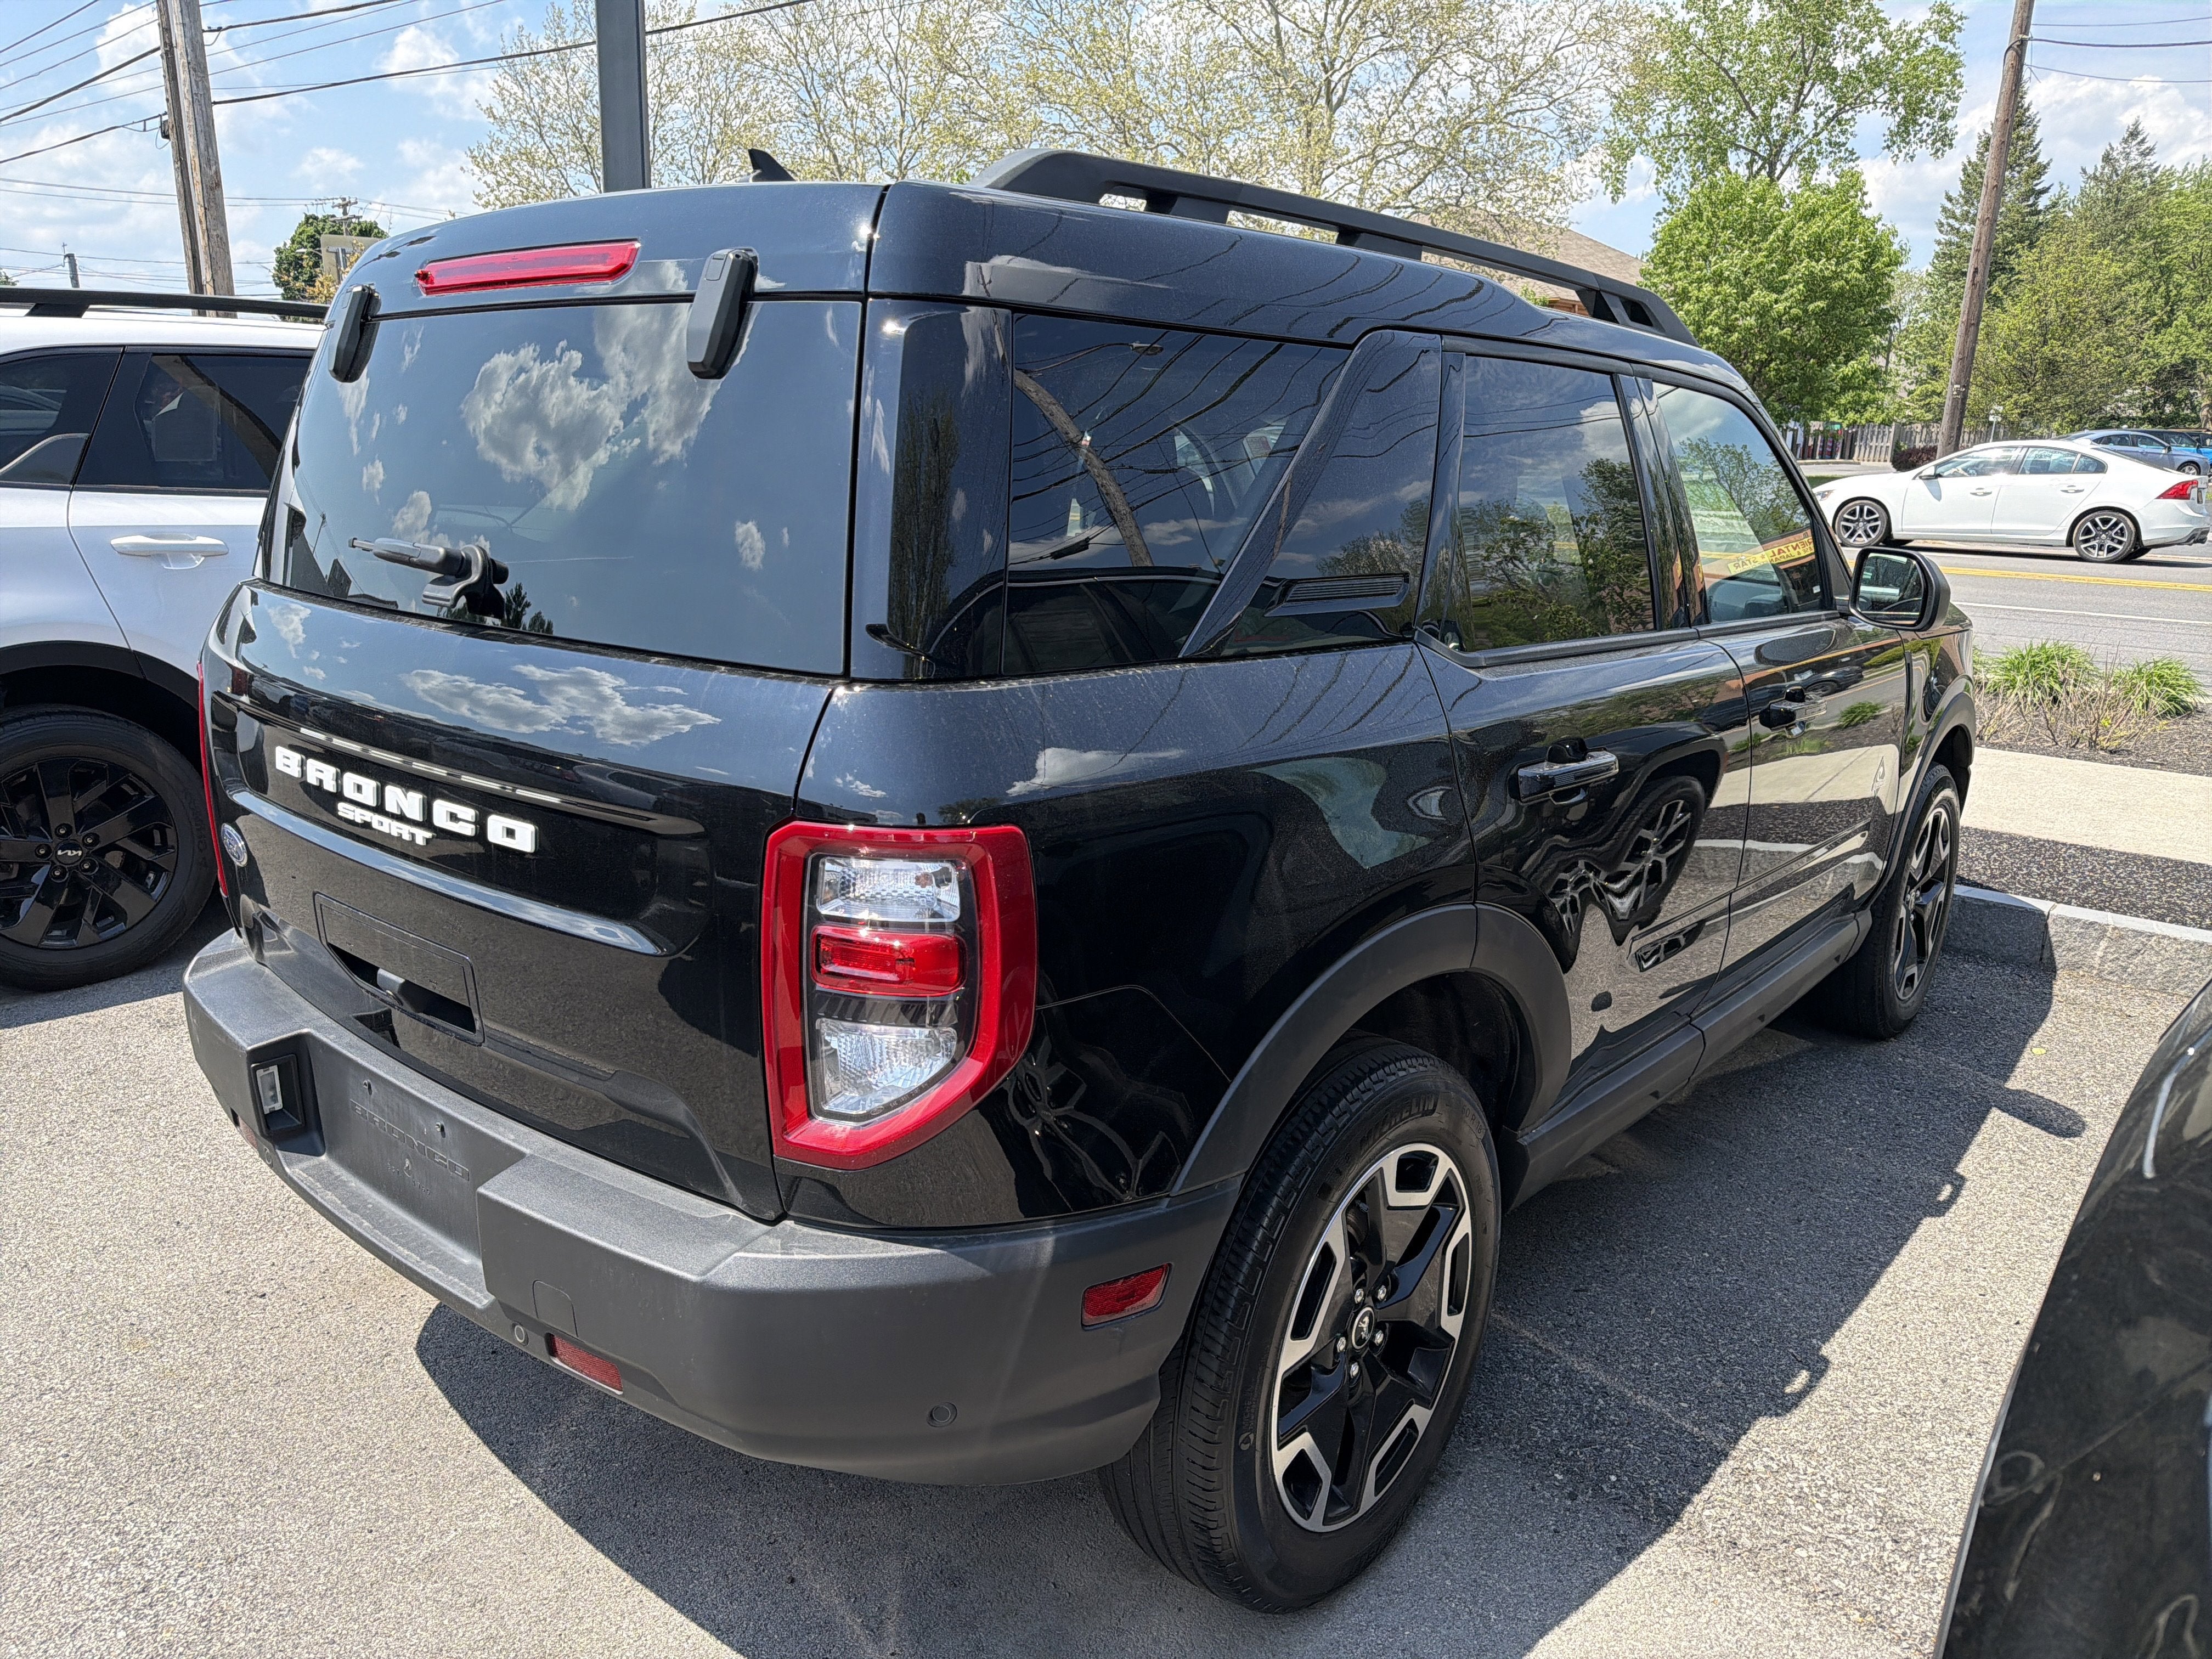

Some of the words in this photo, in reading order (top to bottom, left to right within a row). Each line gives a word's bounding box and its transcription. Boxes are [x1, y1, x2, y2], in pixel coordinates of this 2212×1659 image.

[275, 746, 539, 853] BRONCO
[337, 802, 435, 845] SPORT
[349, 1099, 470, 1181] BRONCO
